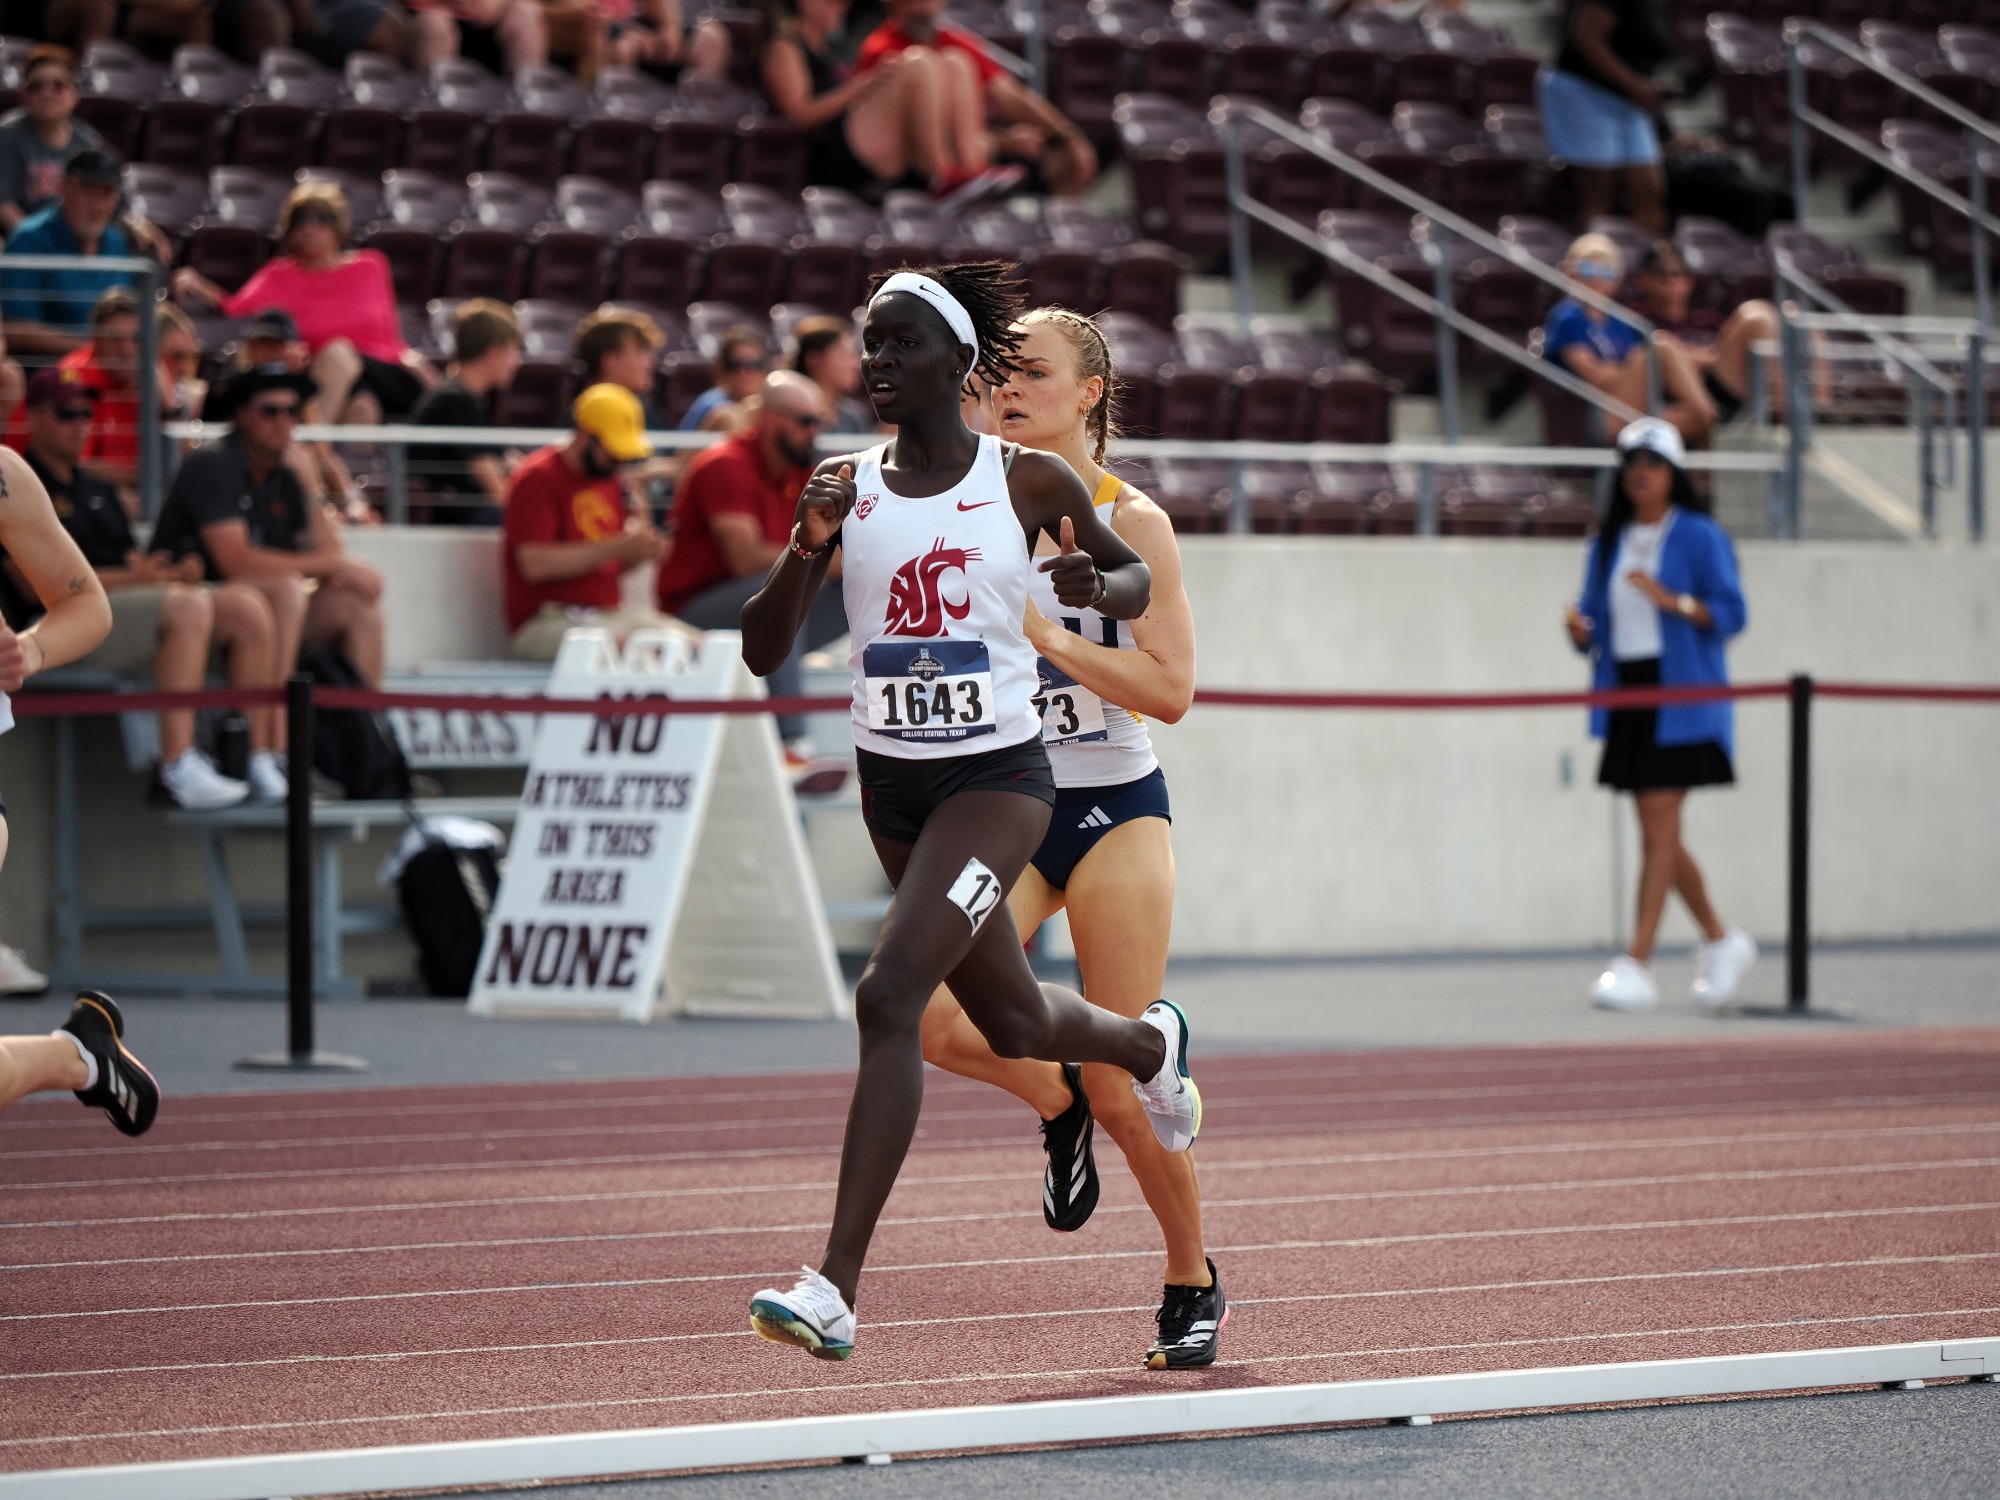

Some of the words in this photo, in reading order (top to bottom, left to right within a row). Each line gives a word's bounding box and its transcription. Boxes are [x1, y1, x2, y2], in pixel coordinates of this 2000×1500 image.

[856, 495, 878, 511] PAC
[858, 504, 871, 516] 12
[405, 692, 519, 754] EXAS
[587, 691, 670, 754] NO
[881, 680, 983, 727] 1643
[901, 730, 924, 738] COLLEGE
[924, 730, 948, 738] STATION,
[949, 728, 967, 737] TEXAS
[526, 770, 695, 812] ATHLETES
[538, 820, 570, 857] IN
[585, 821, 656, 859] THIS
[542, 867, 627, 905] AREA
[965, 874, 1000, 929] 12
[486, 922, 650, 990] NONE
